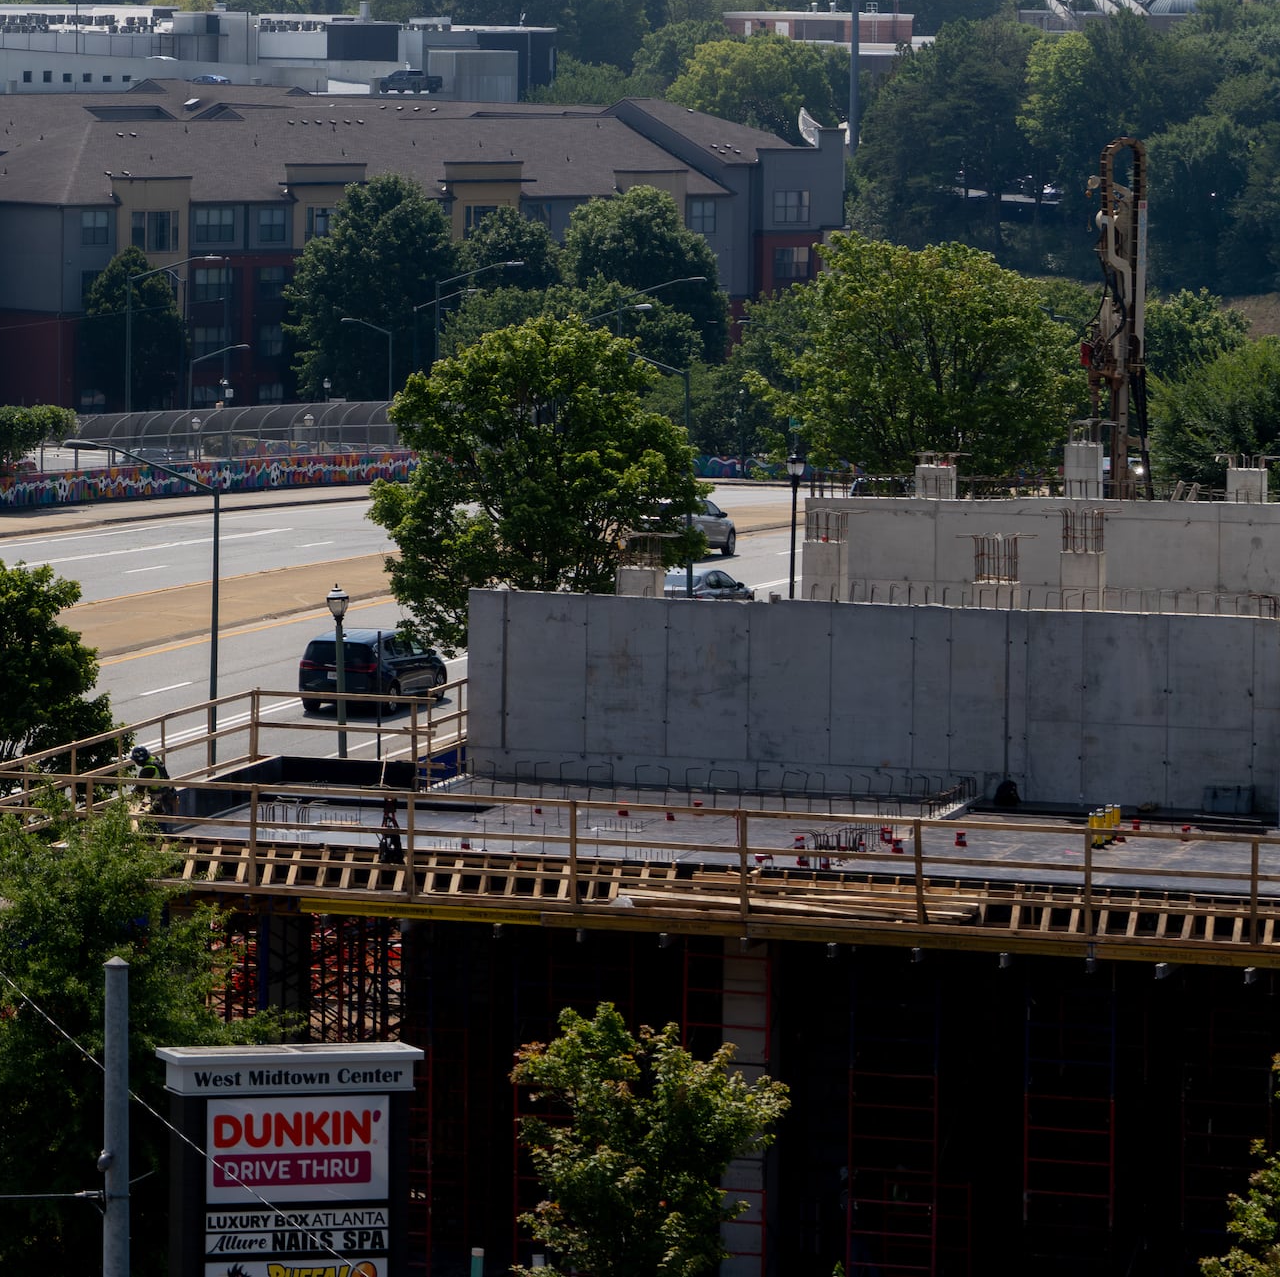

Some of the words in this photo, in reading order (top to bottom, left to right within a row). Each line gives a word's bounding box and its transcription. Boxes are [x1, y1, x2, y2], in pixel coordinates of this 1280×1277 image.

[194, 1070, 242, 1087] West
[248, 1070, 330, 1086] Midtown
[337, 1067, 403, 1085] Center
[213, 1109, 382, 1149] DUNKIN'
[224, 1160, 291, 1181] DRIVE
[297, 1158, 360, 1178] THRU
[207, 1214, 271, 1230] LUXURY
[274, 1213, 311, 1227] BOX
[312, 1211, 387, 1226] ATLANTA
[210, 1234, 268, 1254] Allure
[271, 1230, 334, 1251] NAILS
[343, 1230, 385, 1250] SPA
